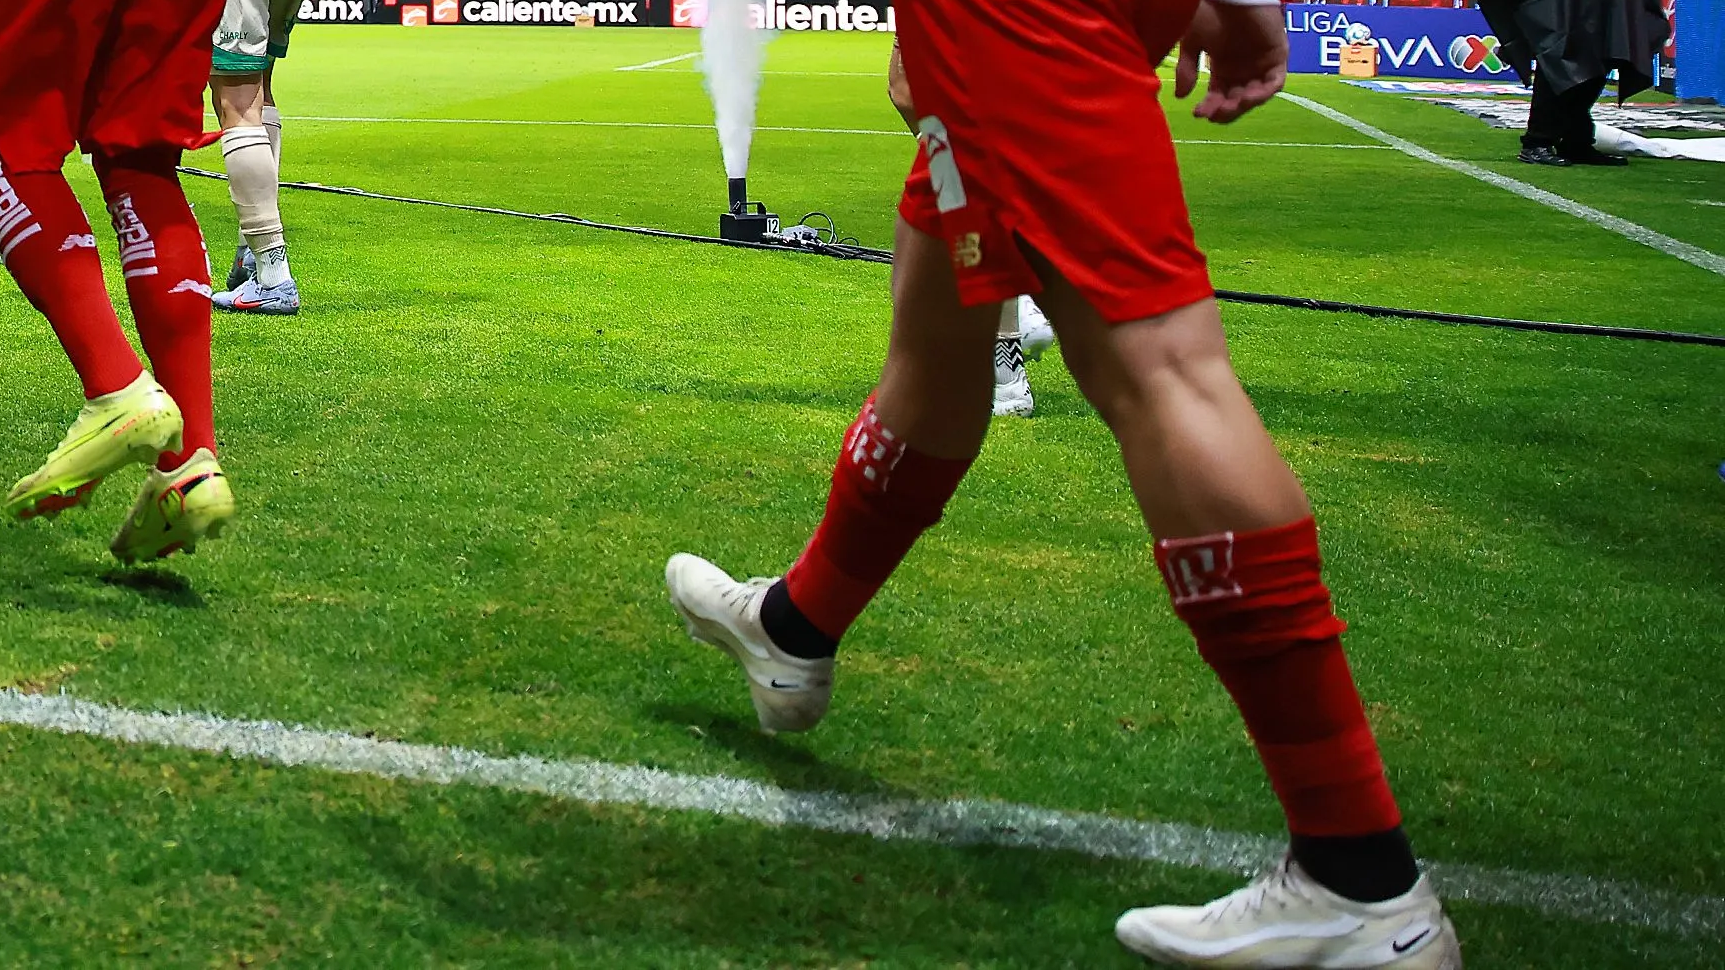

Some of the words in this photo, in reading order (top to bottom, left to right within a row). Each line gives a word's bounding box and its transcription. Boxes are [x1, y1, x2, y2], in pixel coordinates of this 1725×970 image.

[1285, 9, 1351, 34] LIGA
[219, 31, 249, 40] CHARLY
[1318, 35, 1444, 69] BVA
[767, 219, 779, 233] 12
